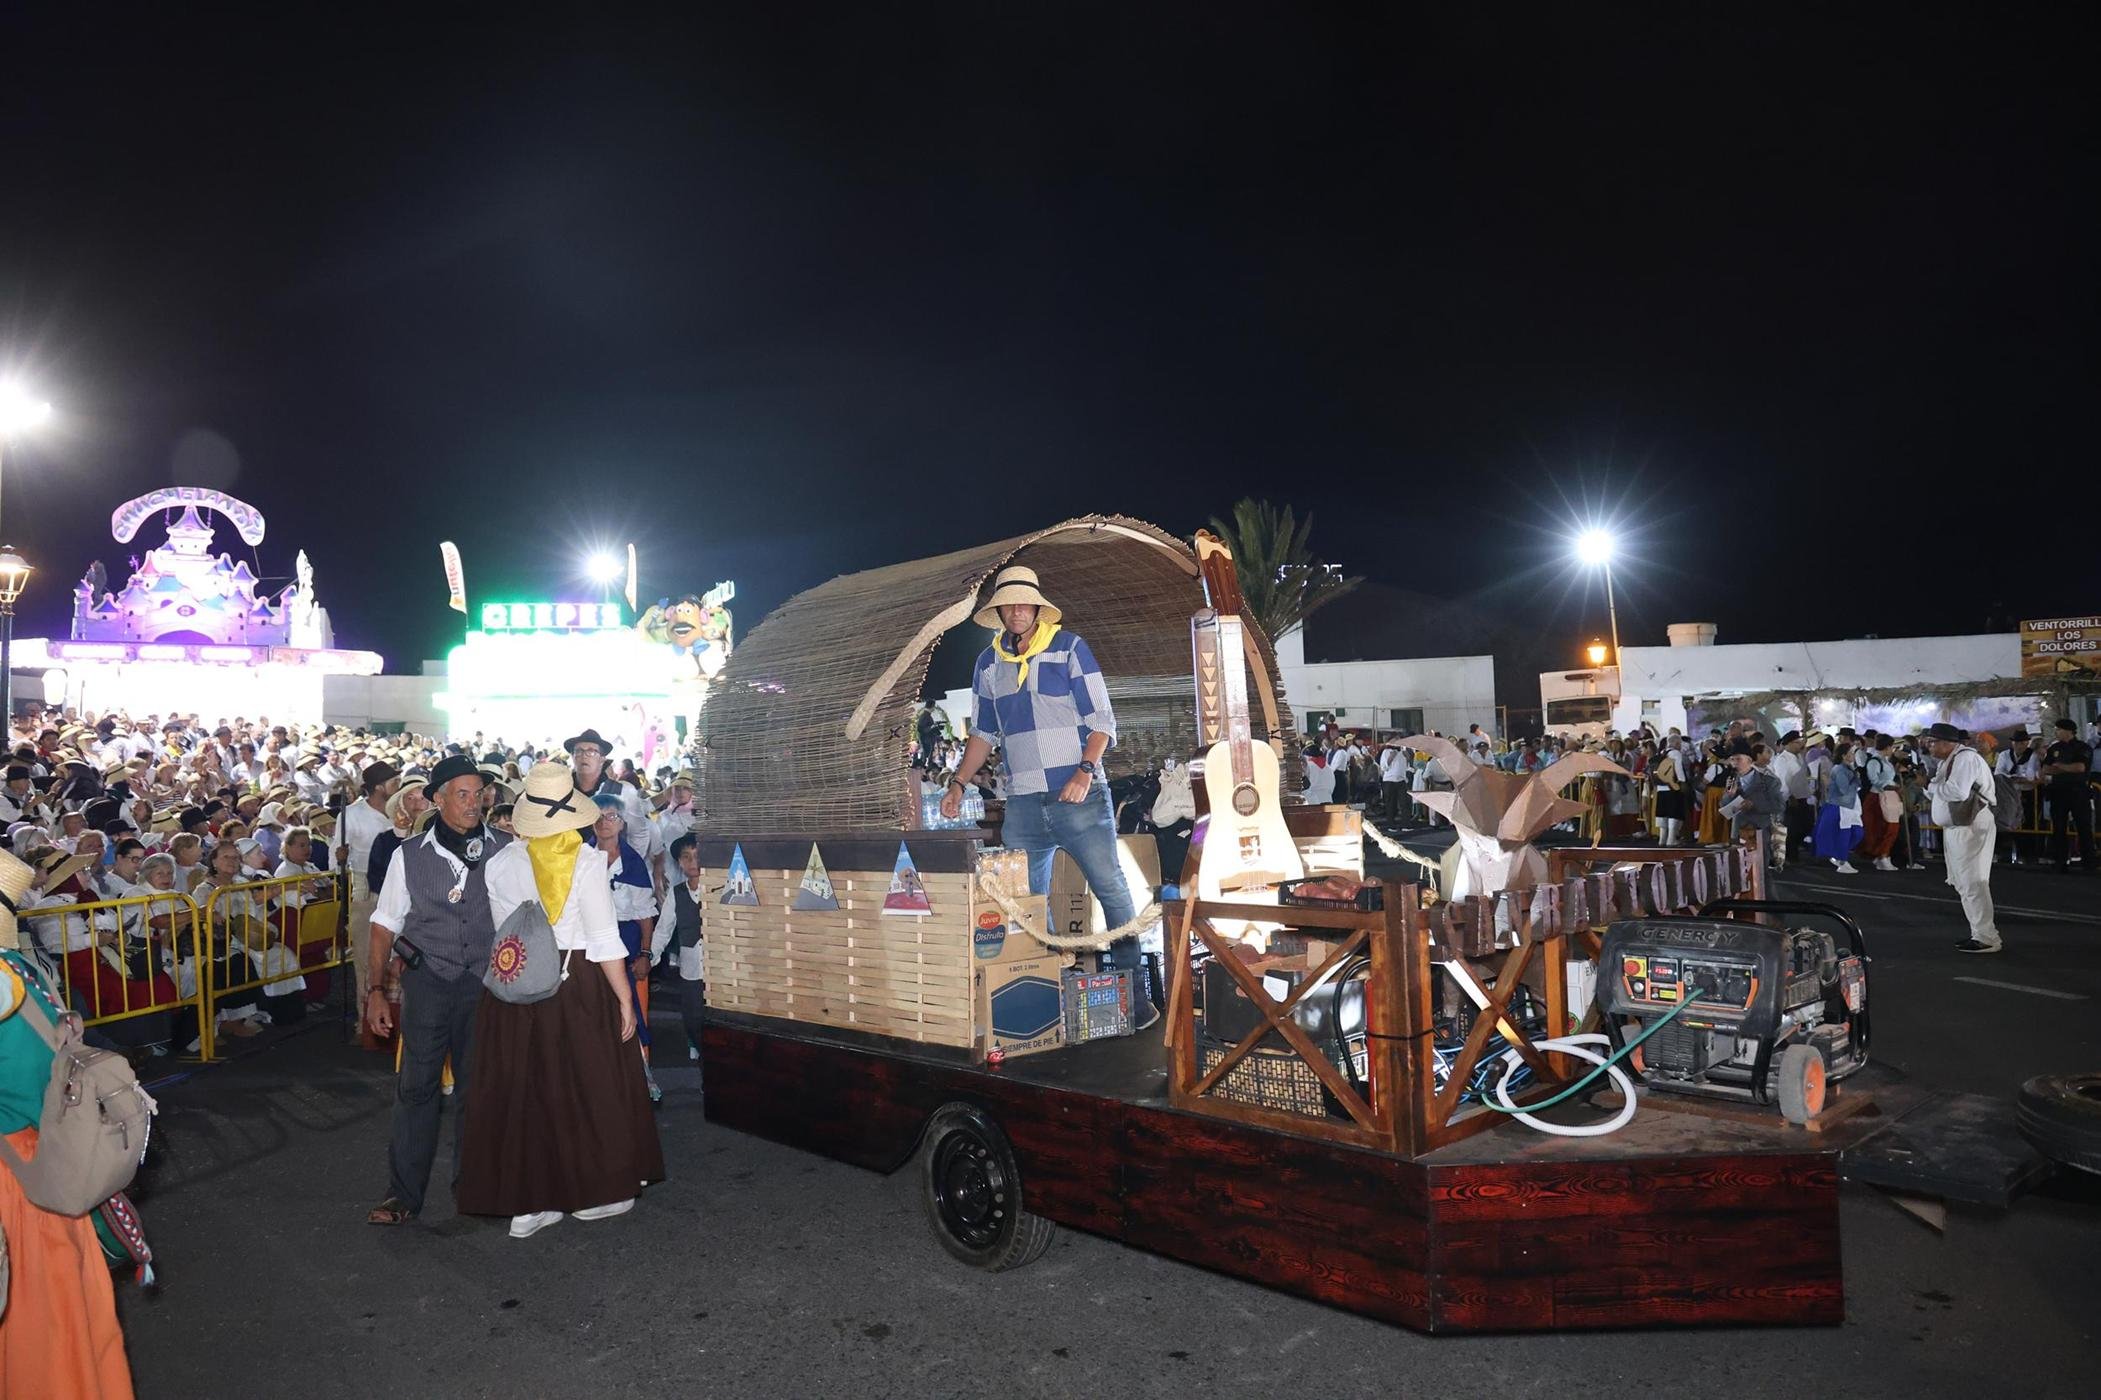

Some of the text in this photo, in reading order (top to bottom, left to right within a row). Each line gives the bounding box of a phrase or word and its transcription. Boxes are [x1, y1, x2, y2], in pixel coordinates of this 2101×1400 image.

[2057, 631, 2081, 641] LOS
[2040, 641, 2097, 652] DOLORES
[1641, 927, 1738, 945] GENERGY
[1033, 1040, 1042, 1048] DE
